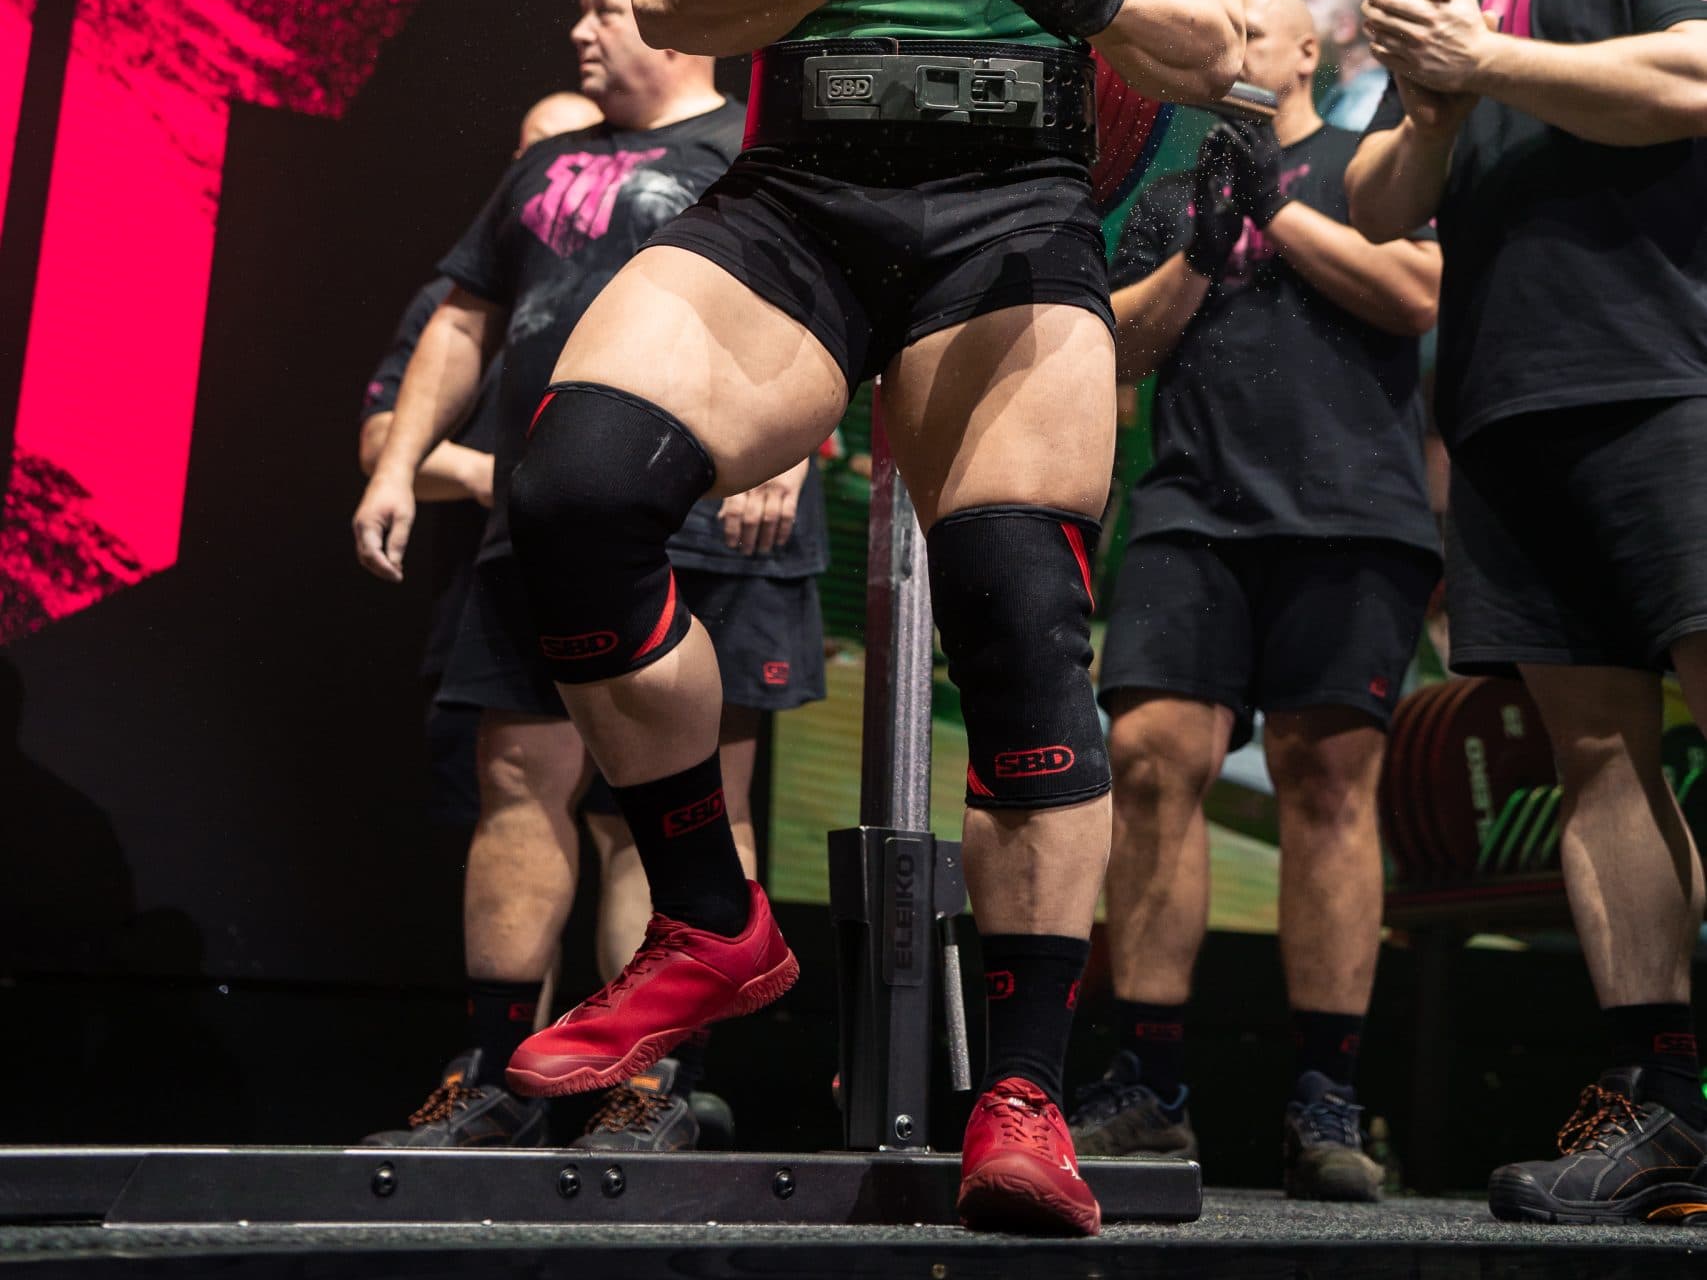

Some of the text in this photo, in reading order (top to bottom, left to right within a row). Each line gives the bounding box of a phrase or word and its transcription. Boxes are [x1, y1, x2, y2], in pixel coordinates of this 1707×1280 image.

[829, 77, 872, 98] SBD
[540, 631, 619, 660] SBD
[994, 745, 1075, 778] SBD
[895, 853, 915, 970] ELEIKO
